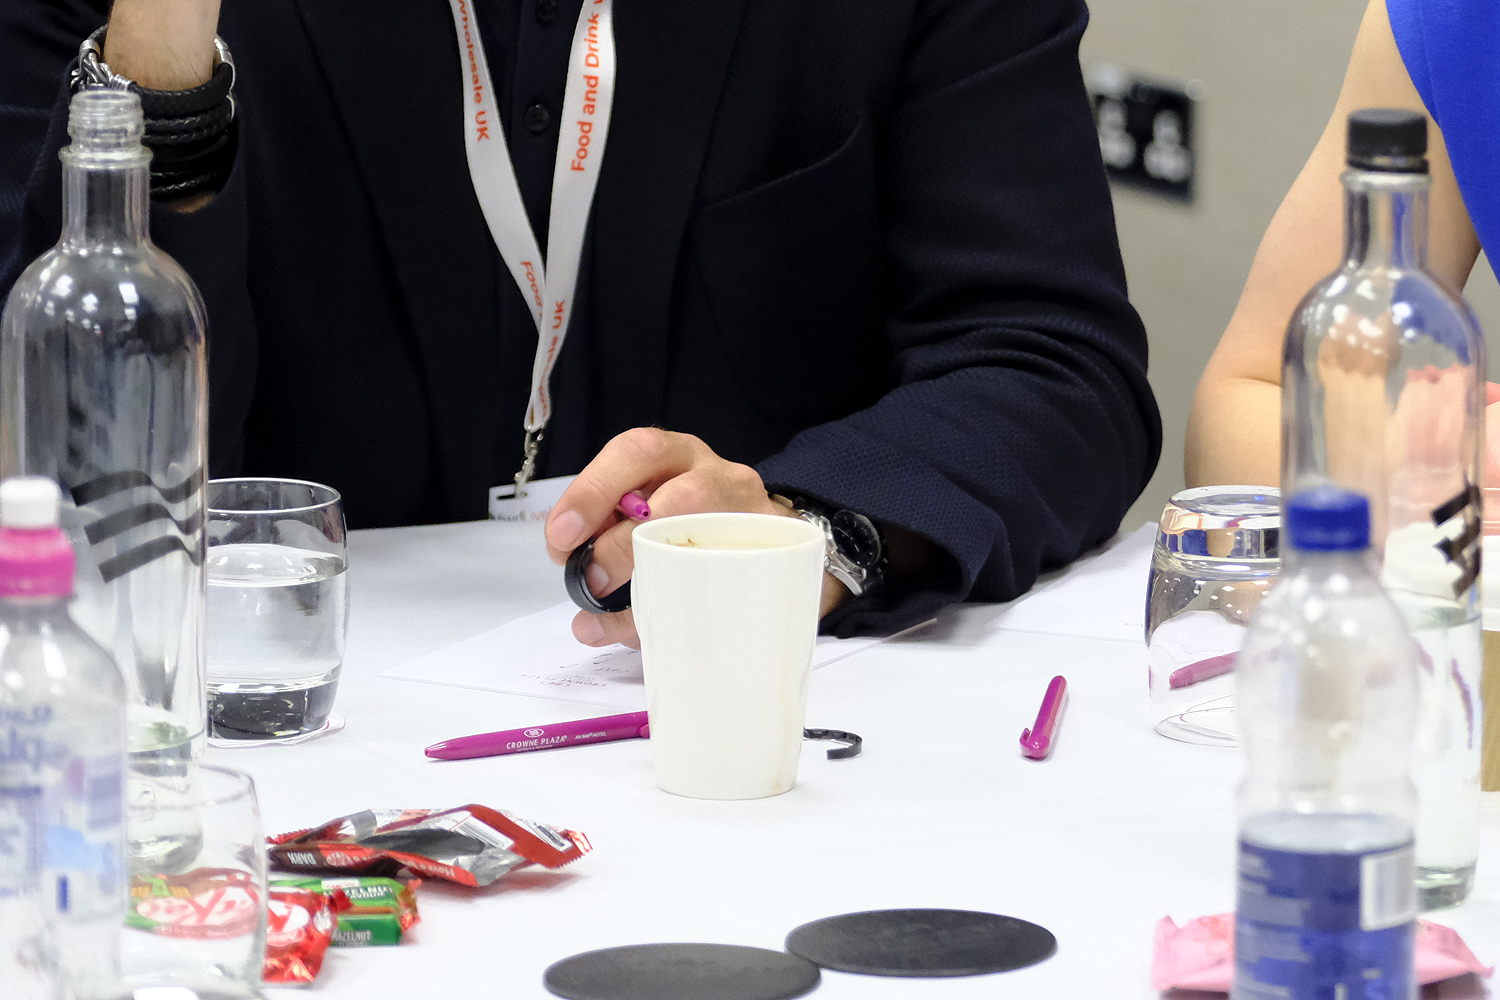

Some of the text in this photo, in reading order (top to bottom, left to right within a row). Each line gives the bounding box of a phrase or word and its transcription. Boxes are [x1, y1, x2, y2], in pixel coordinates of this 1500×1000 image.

[583, 12, 600, 69] Drink
[582, 74, 600, 116] and
[474, 110, 490, 142] UK
[571, 120, 593, 172] Food
[552, 299, 566, 330] UK
[506, 739, 539, 750] CROWNE
[287, 852, 317, 865] DARK
